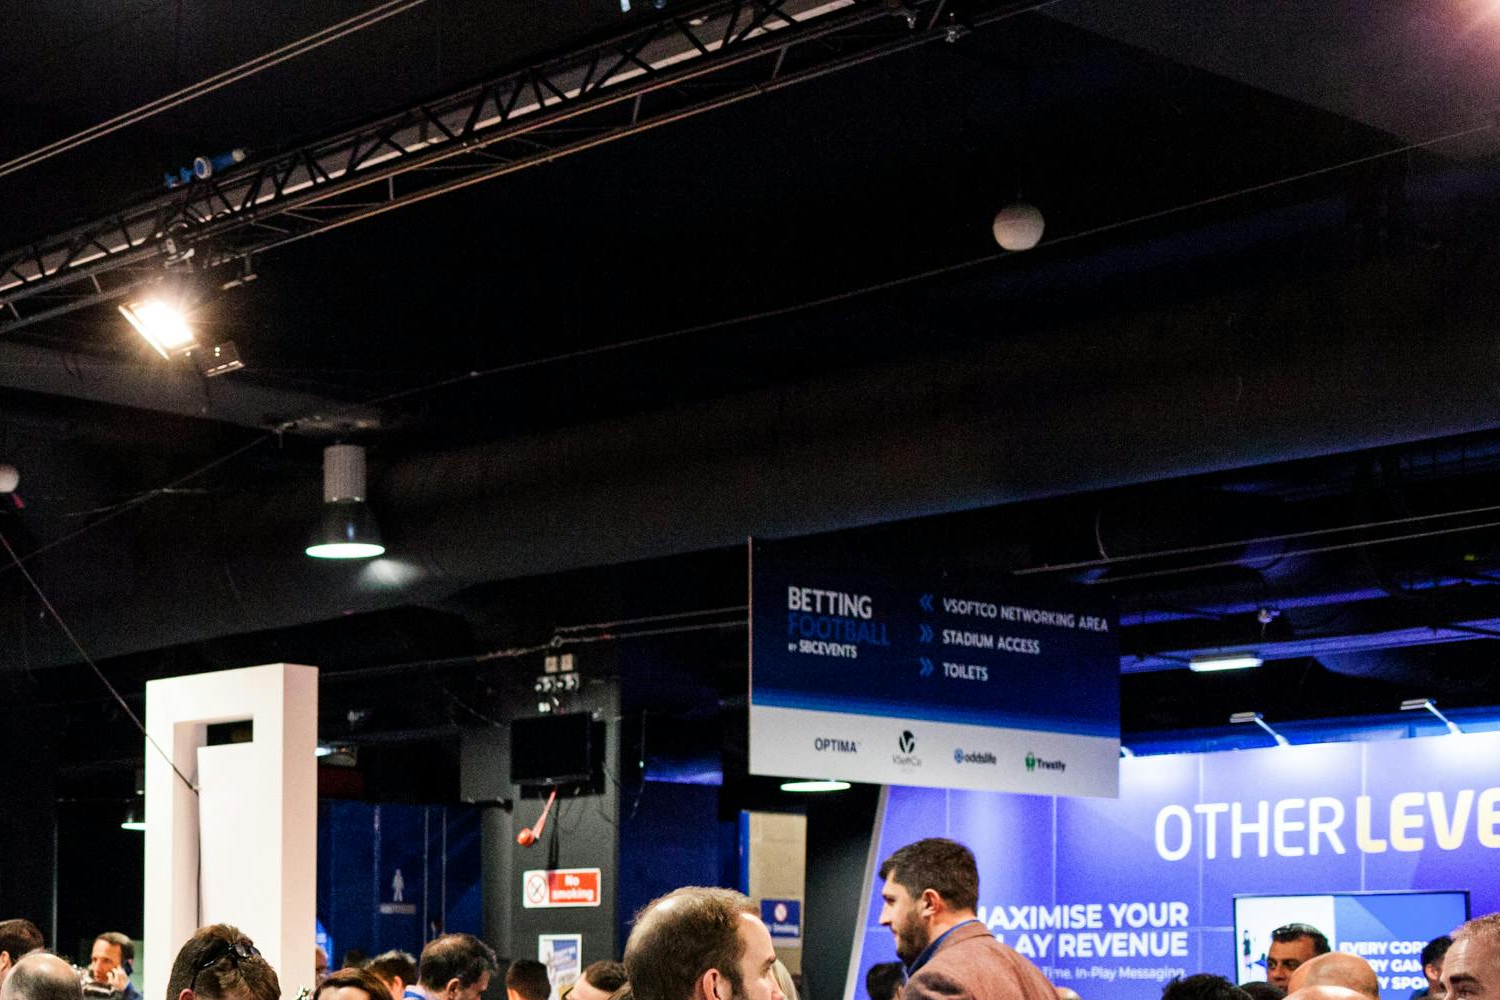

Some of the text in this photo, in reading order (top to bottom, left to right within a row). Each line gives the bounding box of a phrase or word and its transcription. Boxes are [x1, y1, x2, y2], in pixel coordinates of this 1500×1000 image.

[787, 586, 873, 619] BETTING
[943, 598, 1109, 632] VSOFTCO NETWORKING AREA
[787, 611, 891, 646] FOOTBALL
[799, 639, 858, 659] SBCEVENTS
[943, 629, 1040, 654] STADIUM ACCESS
[943, 662, 989, 682] TOILETS
[814, 737, 858, 753] OPTIMA
[564, 874, 581, 887] No
[552, 887, 595, 902] smoking
[1108, 901, 1190, 929] YOUR
[1058, 930, 1190, 958] REVENUE
[1339, 941, 1429, 955] EVERY COR
